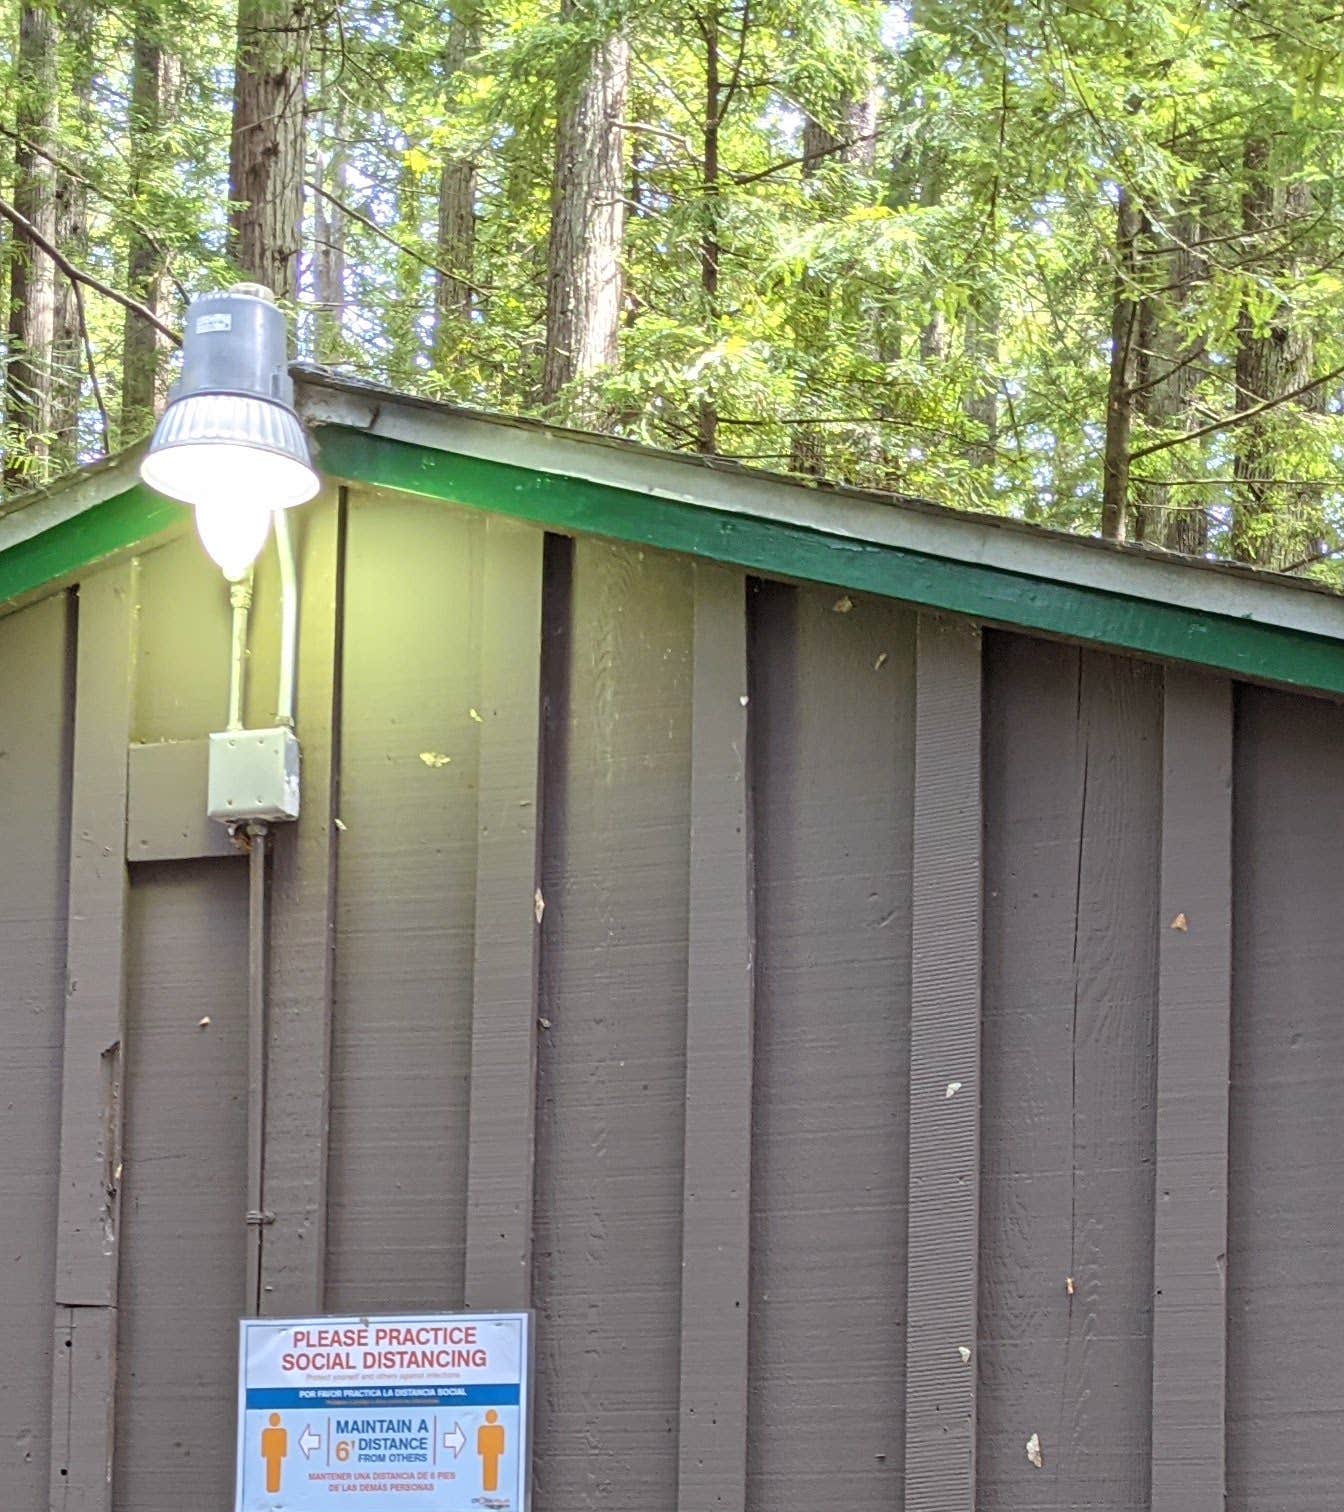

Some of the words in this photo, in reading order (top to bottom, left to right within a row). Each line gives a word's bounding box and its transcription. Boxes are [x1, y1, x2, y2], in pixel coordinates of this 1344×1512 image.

[294, 1329, 368, 1348] PLEASE
[376, 1327, 477, 1347] PRACTICE
[282, 1353, 356, 1371] SOCIAL
[364, 1350, 486, 1369] DISTANCING
[299, 1390, 316, 1398] POR
[318, 1390, 341, 1398] FAVOR
[343, 1389, 381, 1397] PRACTICA
[438, 1388, 467, 1396] SOCIAL
[336, 1419, 411, 1434] MAINTAIN
[418, 1419, 429, 1433] A
[359, 1437, 427, 1450] DISTANCE
[358, 1454, 385, 1462] FROM
[389, 1453, 427, 1462] OTHERS
[309, 1473, 352, 1481] MANTENER
[373, 1472, 415, 1480] DISTANCIA
[417, 1472, 428, 1480] DE
[437, 1471, 455, 1480] PIES
